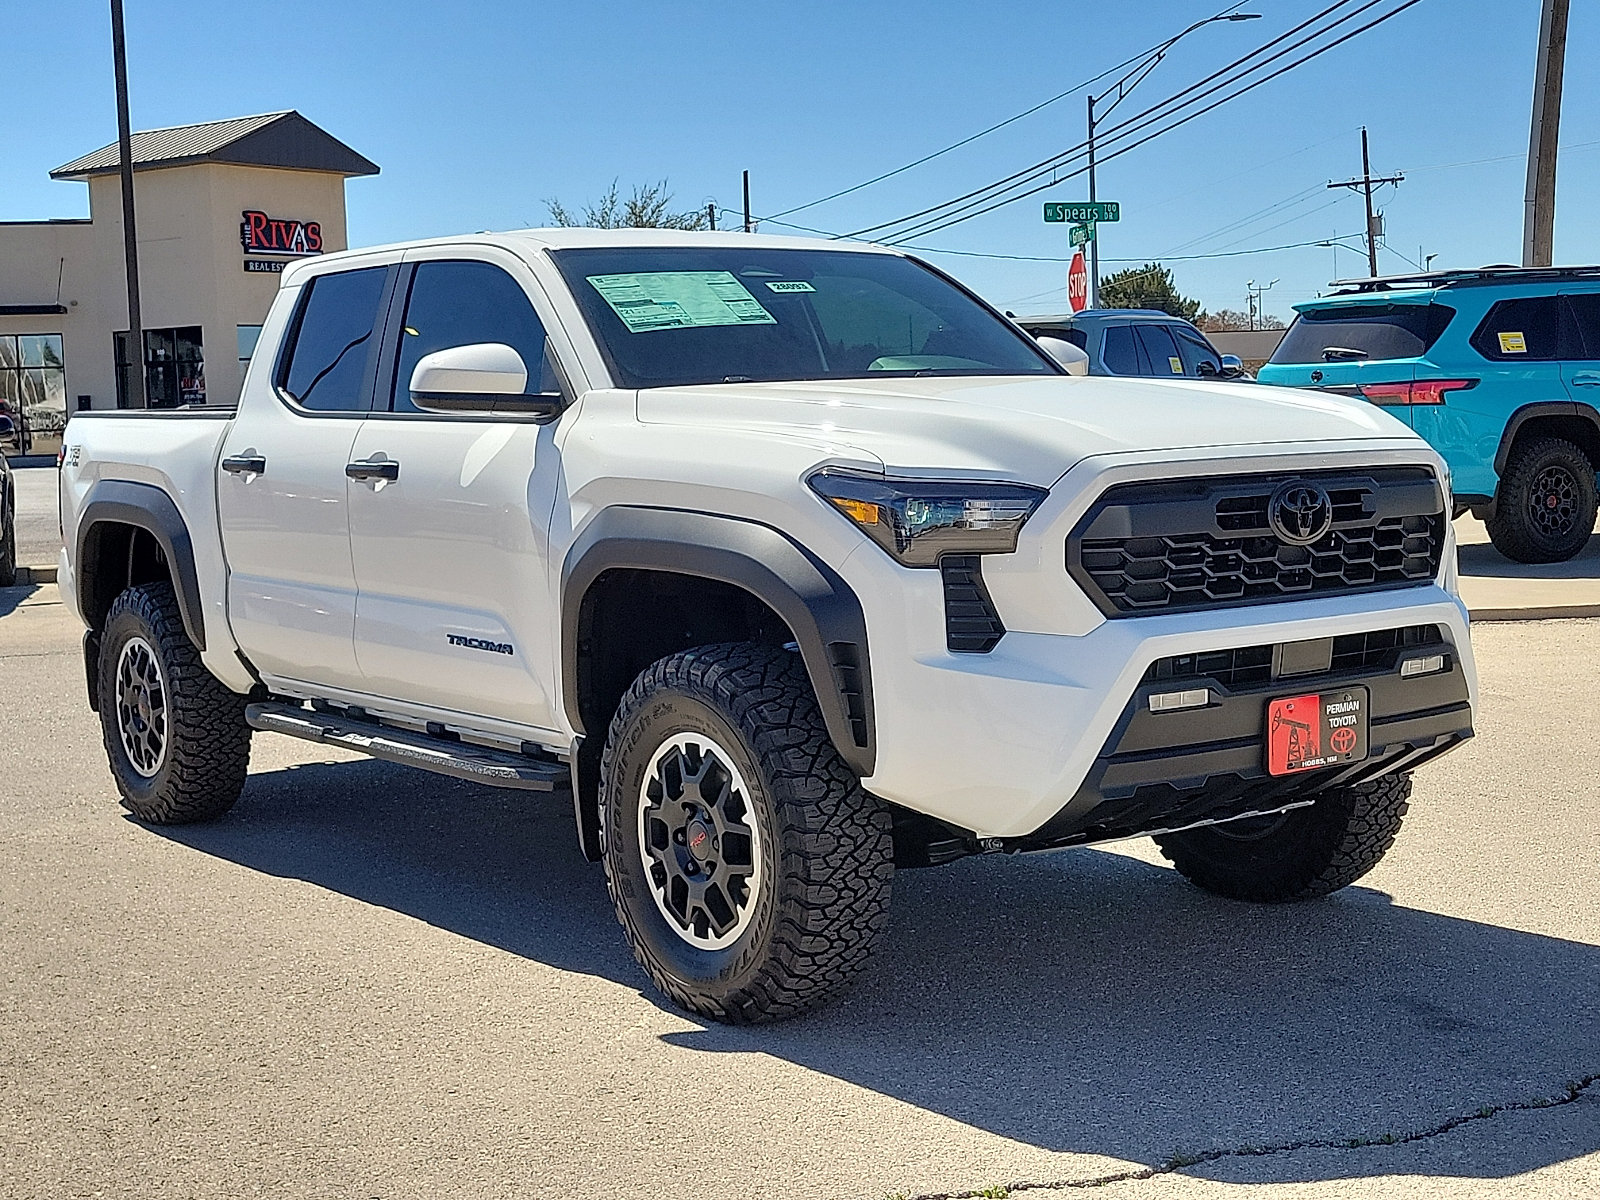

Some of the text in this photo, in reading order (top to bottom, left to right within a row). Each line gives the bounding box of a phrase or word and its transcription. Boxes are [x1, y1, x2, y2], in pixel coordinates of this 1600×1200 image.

[1046, 205, 1098, 221] W Spears
[248, 213, 321, 251] RIVAS
[249, 261, 286, 272] REAL EST
[1069, 272, 1086, 298] STOP
[446, 633, 514, 656] TACOMA
[1326, 700, 1360, 715] PERMIAN
[1328, 715, 1358, 728] TOYOTA
